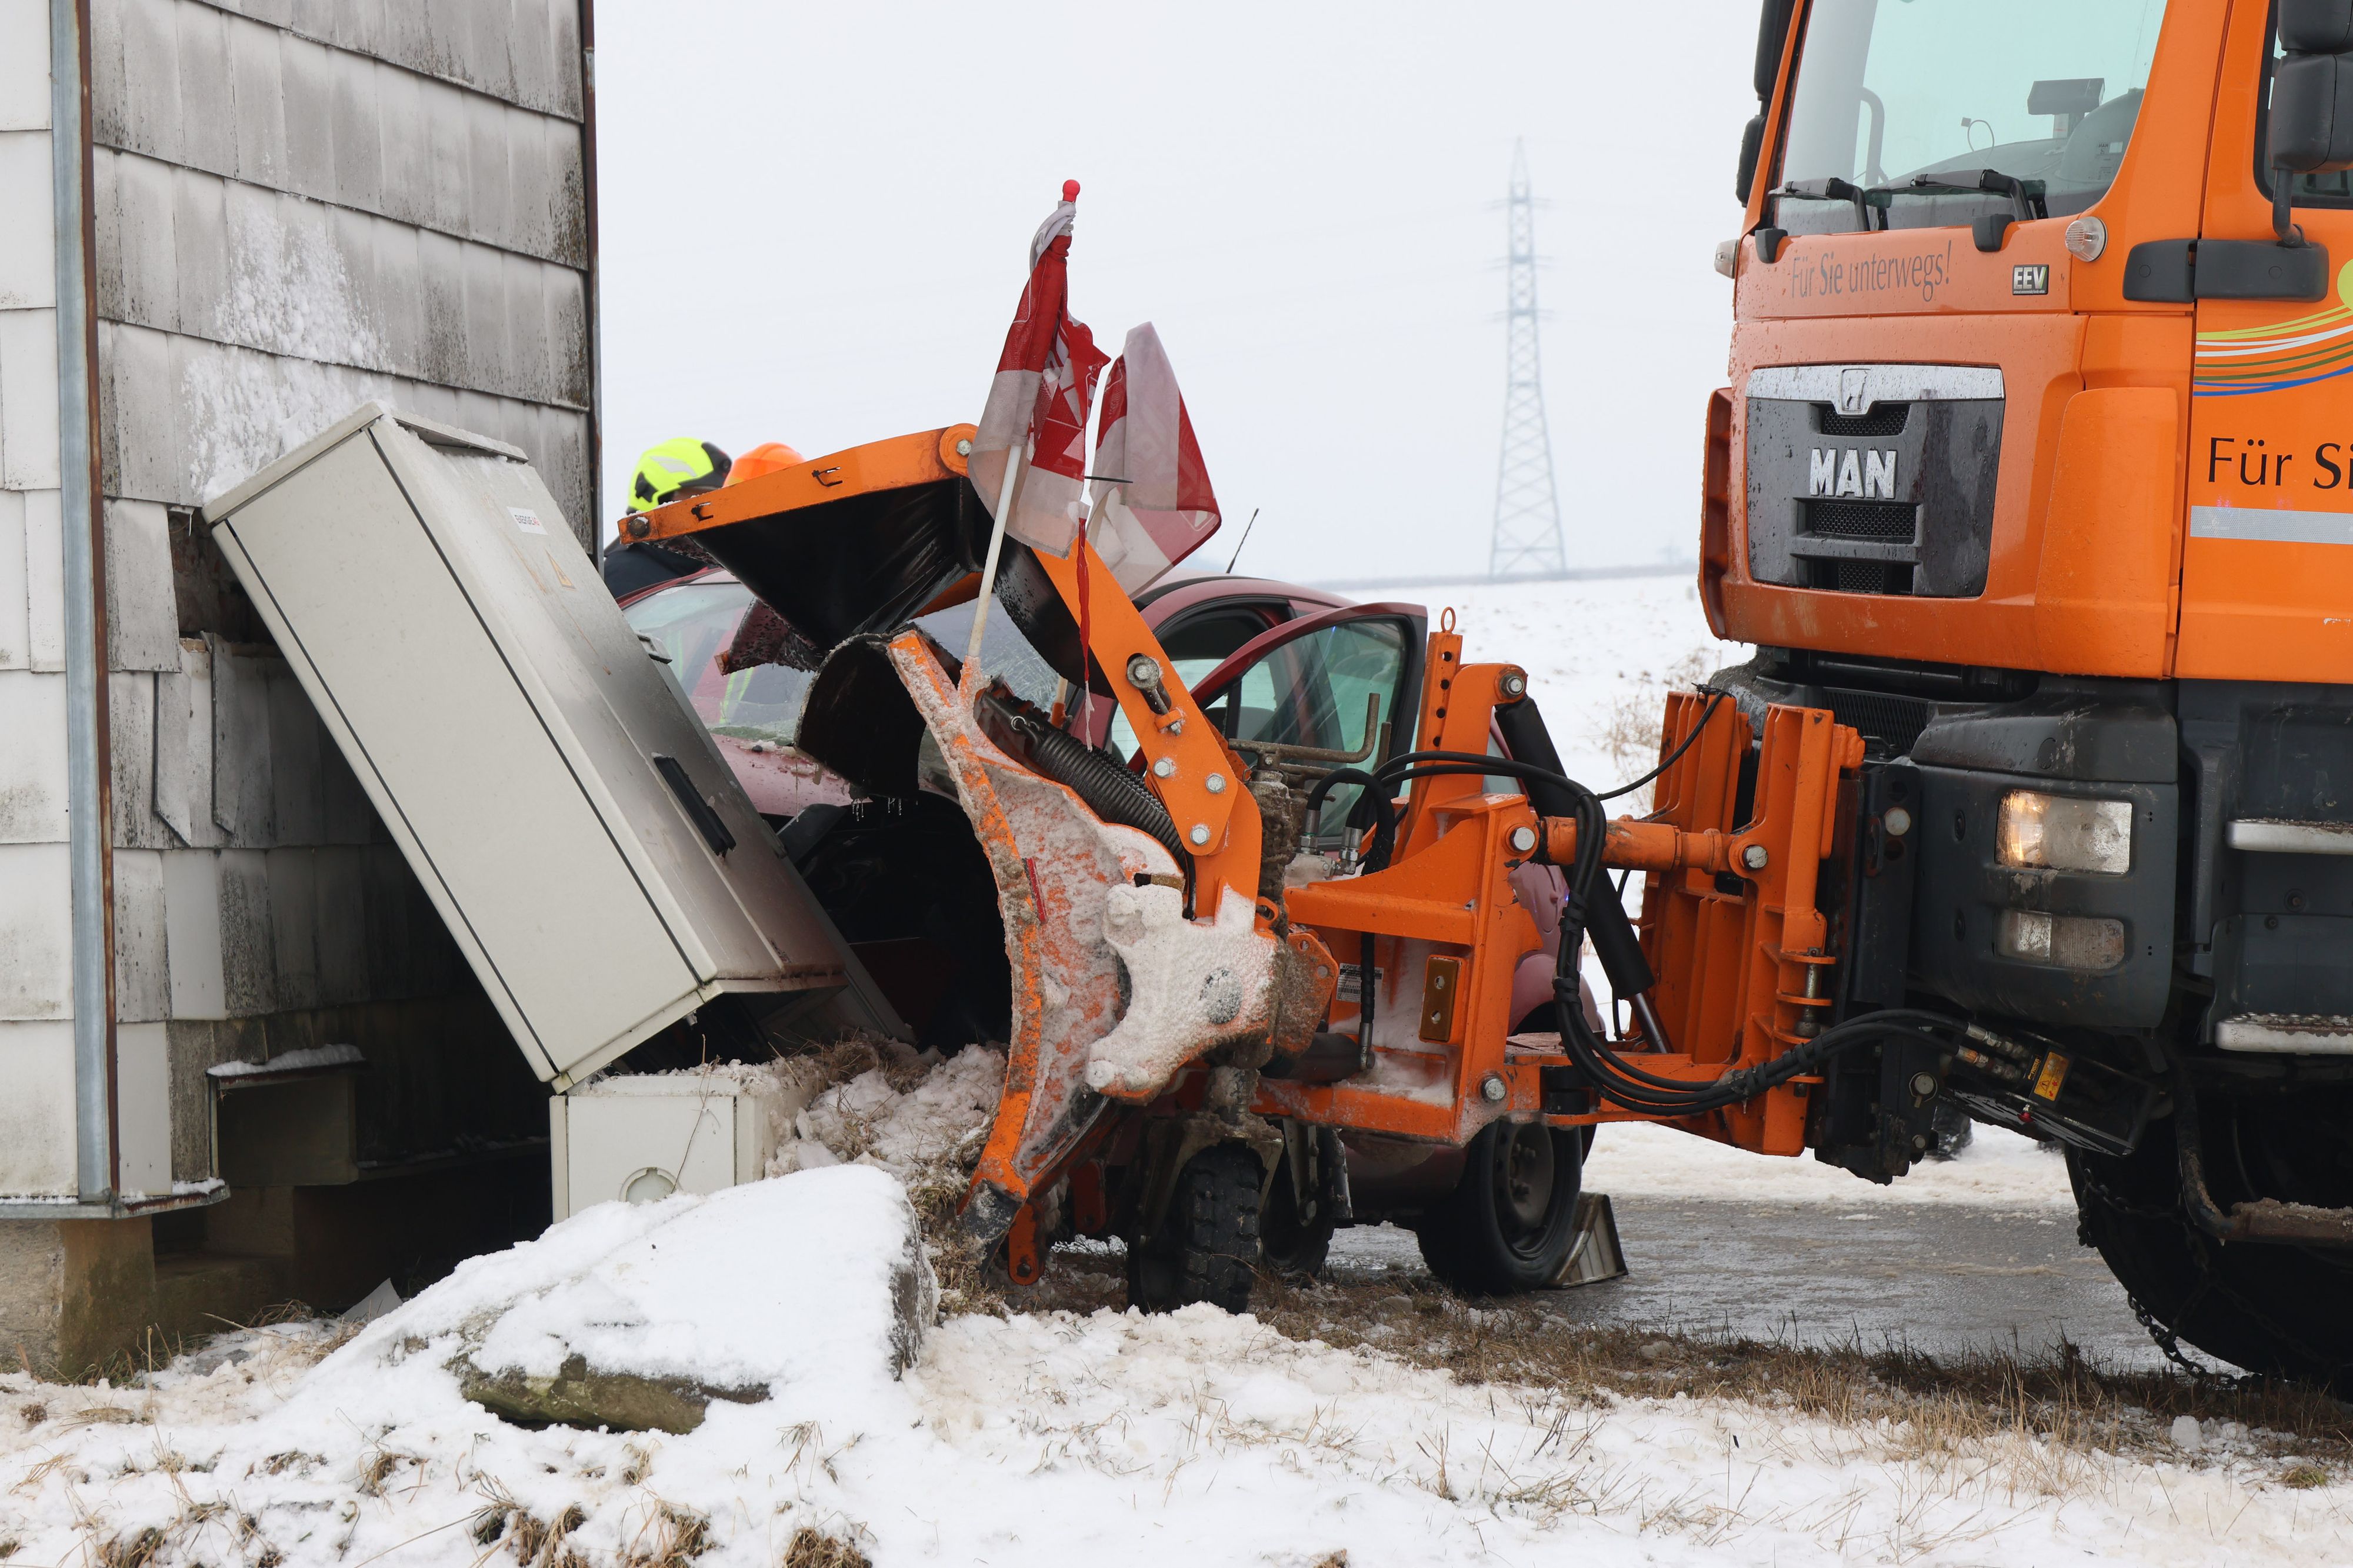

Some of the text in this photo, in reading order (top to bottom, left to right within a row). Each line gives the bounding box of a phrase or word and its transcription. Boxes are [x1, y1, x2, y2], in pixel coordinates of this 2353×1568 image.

[1791, 240, 1952, 302] Für Sie unterwegs!
[2013, 267, 2047, 289] EEV
[1809, 449, 1897, 499] MAN
[2208, 437, 2292, 486] Für
